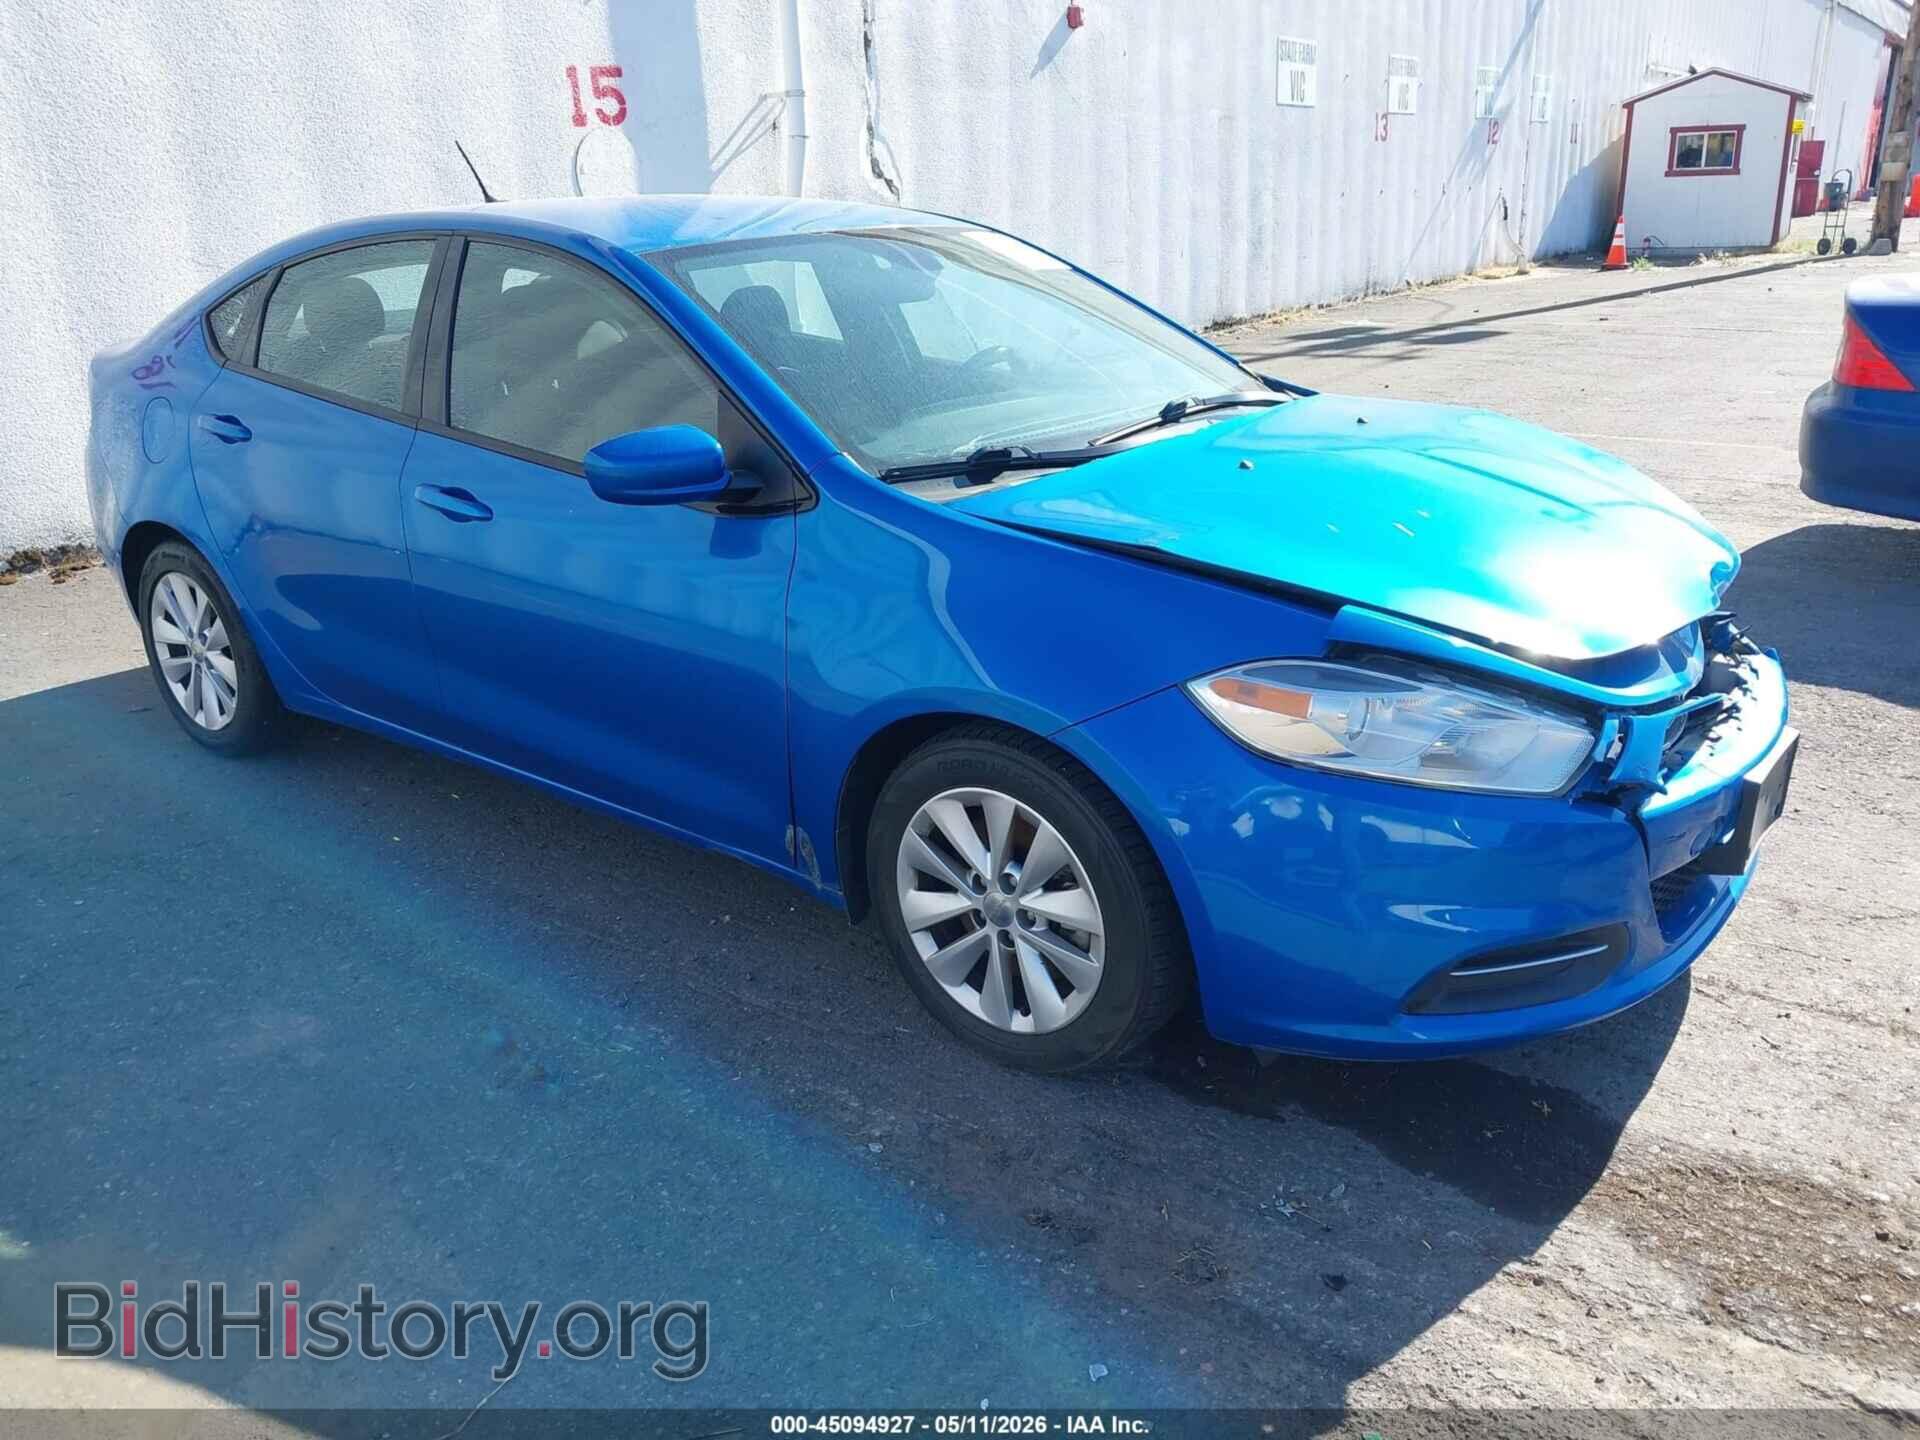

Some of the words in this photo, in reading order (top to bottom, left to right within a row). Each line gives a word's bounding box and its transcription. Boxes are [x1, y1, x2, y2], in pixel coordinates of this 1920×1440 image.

[566, 65, 627, 127] 15
[1375, 112, 1389, 142] 13
[1487, 118, 1500, 145] 12
